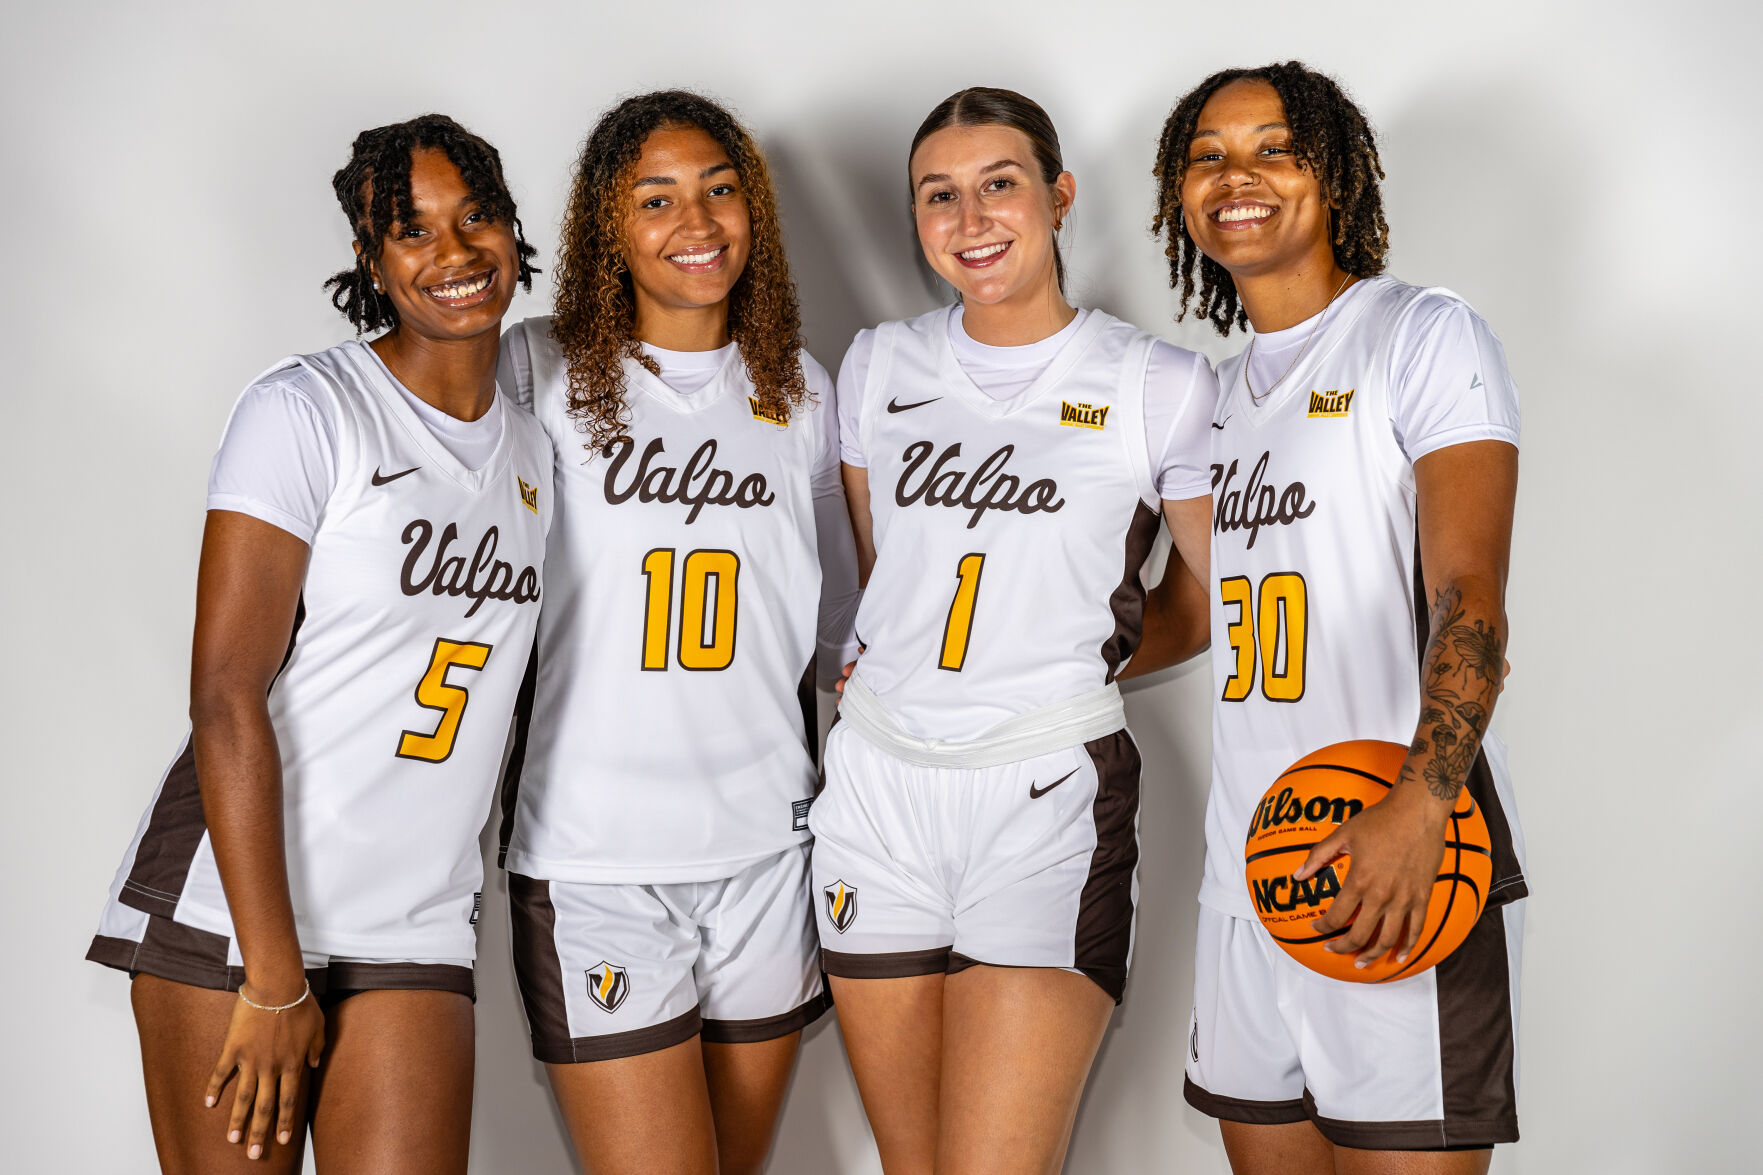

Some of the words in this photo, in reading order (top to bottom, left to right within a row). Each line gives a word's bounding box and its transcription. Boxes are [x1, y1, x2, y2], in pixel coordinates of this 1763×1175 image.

[1061, 400, 1110, 426] VALLEY
[1078, 402, 1093, 410] THE
[1308, 388, 1355, 413] VALLEY
[602, 437, 775, 525] Valpo
[895, 440, 1066, 529] Valpo
[400, 518, 541, 618] Valpo
[641, 547, 741, 672] 10
[938, 552, 987, 673] 1
[1220, 571, 1309, 703] 30
[395, 637, 494, 764] 5
[1278, 826, 1297, 834] GAME
[1252, 864, 1342, 913] NCAA
[1289, 912, 1317, 921] GAME
